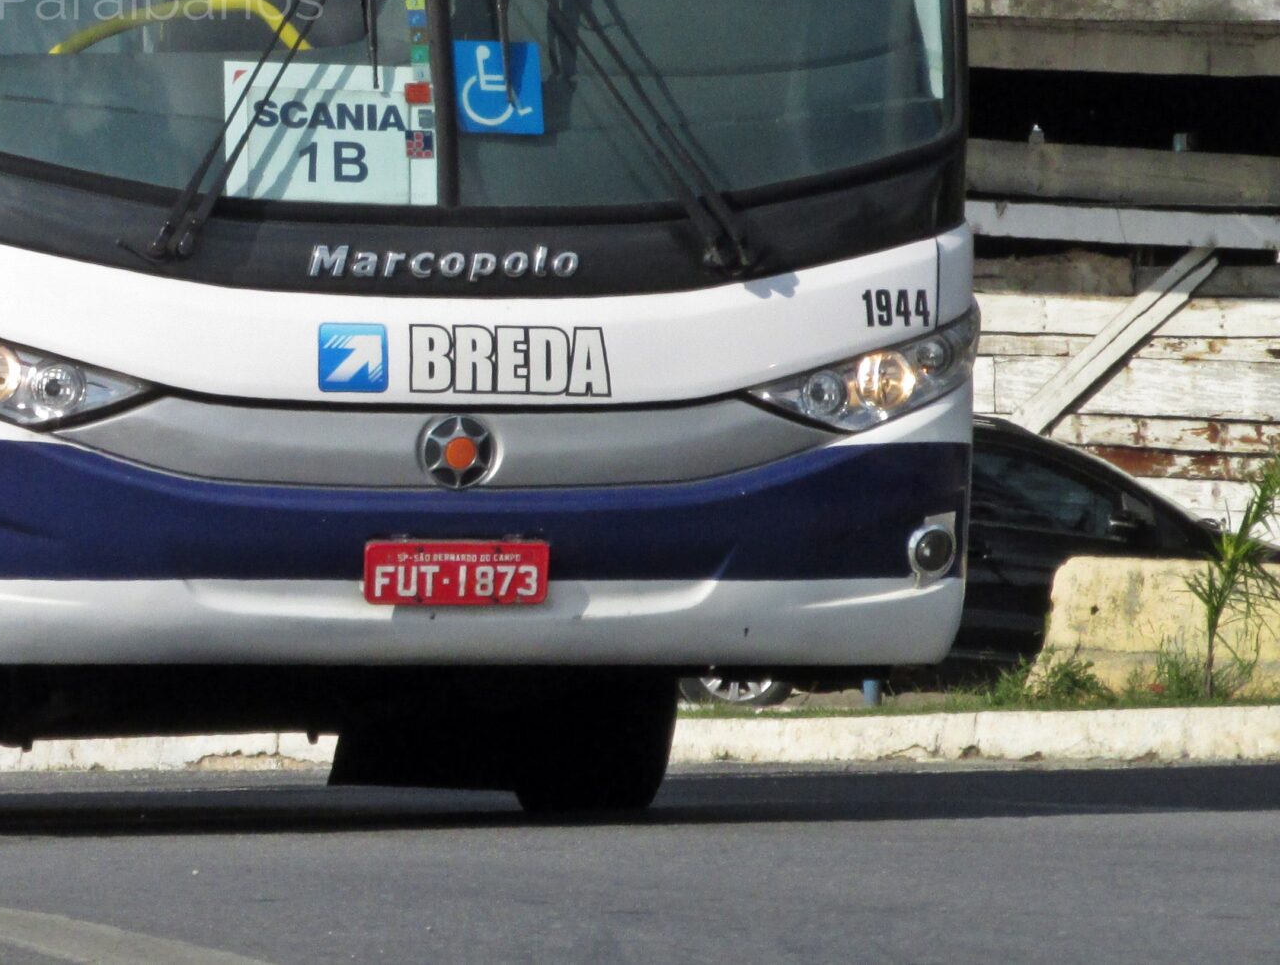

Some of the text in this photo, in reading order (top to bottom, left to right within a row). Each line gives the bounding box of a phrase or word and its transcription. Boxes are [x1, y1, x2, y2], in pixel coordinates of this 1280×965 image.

[254, 100, 407, 132] SCANIA
[308, 245, 579, 282] Marcopolo
[862, 289, 930, 327] 1944
[409, 324, 612, 397] BREDA
